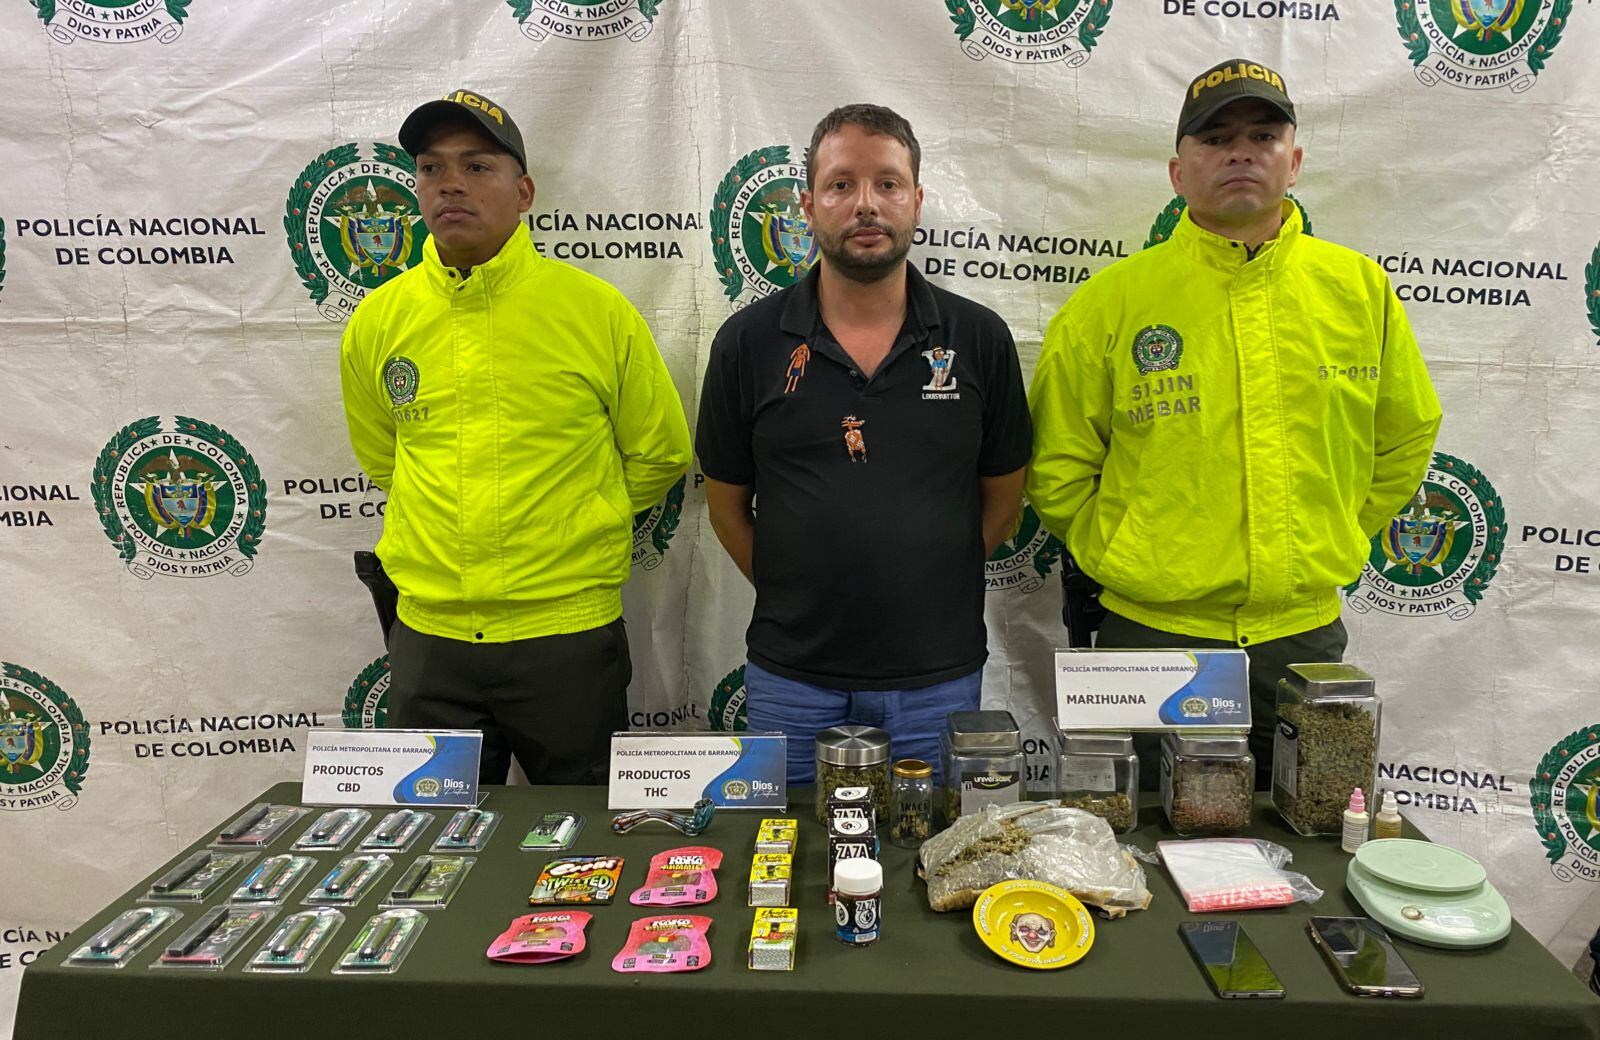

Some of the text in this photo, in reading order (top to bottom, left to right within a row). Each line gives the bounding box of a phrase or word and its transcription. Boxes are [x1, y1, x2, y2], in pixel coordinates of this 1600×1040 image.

[60, 0, 158, 21] ICÍA NACIO
[538, 0, 629, 19] ICÍA NACIO
[1163, 0, 1340, 21] DE COLOMBIA
[66, 16, 101, 37] DIOS
[115, 17, 162, 40] PATRIA
[540, 14, 572, 34] DIOS
[587, 15, 633, 37] PATRIA
[1027, 5, 1089, 44] NACIONAL
[982, 35, 1013, 57] DIOS
[1026, 42, 1072, 61] PATRIA
[1478, 26, 1541, 68] NACIONAL
[1192, 62, 1284, 99] POLICIA
[1435, 59, 1463, 84] DIOS
[1473, 66, 1520, 86] PATRIA
[307, 170, 346, 245] REPÚBLICA
[361, 163, 380, 174] DE
[731, 169, 776, 239] REPÚBLICA
[16, 213, 266, 237] POLICÍA NACIONAL
[528, 209, 703, 232] ICÍA NACIONAL
[534, 241, 684, 259] E COLOMBIA
[912, 227, 1129, 258] OLICÍA NACIONAL
[55, 246, 234, 265] DE COLOMBIA
[1376, 251, 1568, 281] ICÍA NACIONAL
[925, 257, 1091, 284] DE COLOMBIA
[338, 297, 358, 313] DI
[1395, 284, 1532, 307] COLOMBIA
[1132, 373, 1194, 401] SIJIN
[1127, 396, 1201, 426] MEBAR
[114, 435, 247, 509] REPÚBLICA DE COLOMBIA
[0, 484, 80, 501] IONAL
[0, 510, 54, 527] MBIA
[319, 503, 352, 519] DE
[1427, 471, 1485, 548] E COLOMBIA
[633, 512, 660, 544] IONAL
[1522, 525, 1600, 547] POLIC
[126, 520, 243, 560] POLICÍA NACIONAL
[147, 556, 178, 573] DIOS
[191, 555, 234, 575] PATRIA
[631, 547, 648, 562] RIA
[985, 537, 1044, 573] NACIONAL
[1555, 554, 1591, 574] DE
[1362, 562, 1475, 598] OLICÍA NACIONAL
[1366, 590, 1395, 610] DIOS
[1409, 597, 1456, 613] PATRIA
[1062, 665, 1091, 673] POLICÍA
[0, 678, 71, 744] E COLOMBIA
[364, 675, 390, 729] EPÚBLIC
[725, 689, 747, 730] EPÚBLI
[1066, 694, 1147, 705] MARIHUANA
[1212, 697, 1235, 708] Dios
[99, 711, 325, 736] POLICÍA NACIONAL
[631, 703, 700, 727] CIONAL
[134, 737, 296, 758] DE COLOMBIA
[312, 744, 338, 752] POLICÍA
[17, 757, 69, 794] NACIONAL
[312, 765, 384, 776] PRODUCTOS
[618, 770, 691, 780] PRODUCTOS
[1377, 762, 1513, 792] NACIONAL
[1553, 745, 1600, 806] REPÚBLIC
[337, 782, 361, 793] CBD
[443, 778, 464, 788] Dios
[643, 787, 668, 797] THC
[752, 780, 773, 790] Dios
[20, 790, 61, 808] PATRIA
[1393, 789, 1479, 814] OMBIA
[837, 845, 868, 859] ZAZA
[1571, 859, 1597, 878] DIOS
[857, 900, 876, 911] ZAZA
[0, 953, 11, 969] E
